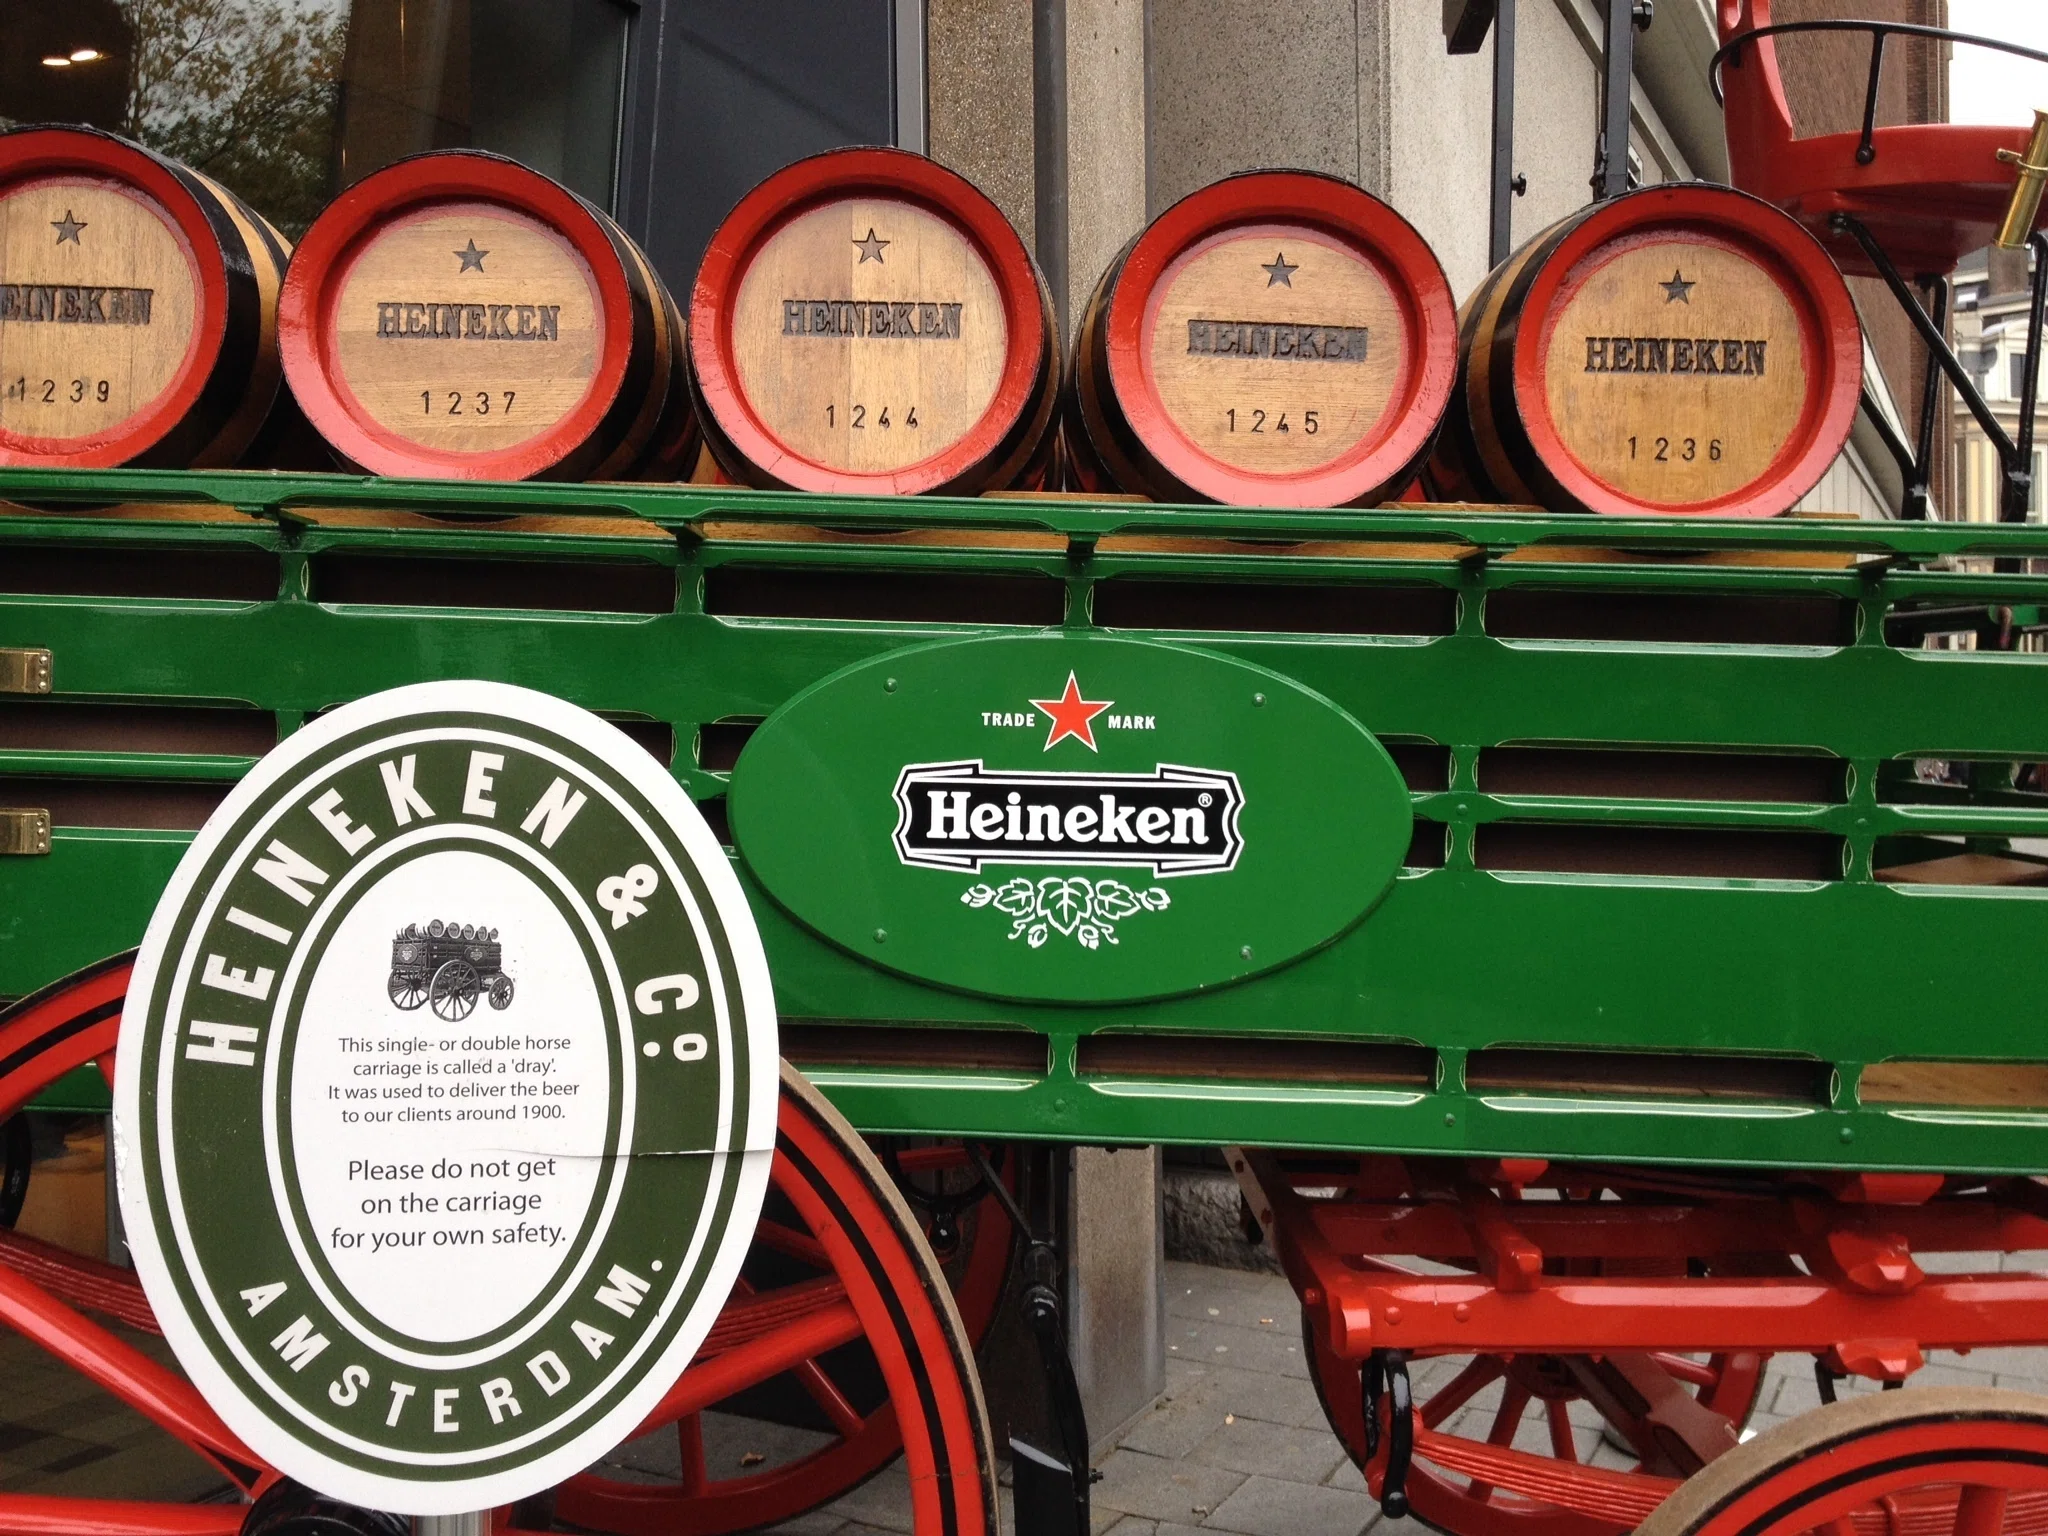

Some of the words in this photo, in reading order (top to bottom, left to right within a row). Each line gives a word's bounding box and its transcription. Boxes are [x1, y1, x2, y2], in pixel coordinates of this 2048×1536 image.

[0, 284, 153, 325] EINEKEN
[376, 302, 561, 342] HEINEKEN
[781, 300, 963, 339] HEINEKEN
[1187, 319, 1369, 362] HEINEKEN
[1584, 336, 1768, 376] HEINEKEN
[16, 376, 110, 403] 1239
[420, 390, 516, 415] 1237
[825, 404, 919, 429] 1244
[1226, 408, 1319, 435] 1245
[1627, 436, 1722, 461] 1236
[981, 712, 1036, 728] TRADE
[1107, 715, 1156, 730] MARK
[186, 750, 588, 1066] HEINEKEN
[597, 864, 658, 930] &
[339, 1037, 372, 1052] This
[378, 1036, 435, 1055] single-
[439, 1040, 457, 1051] or
[461, 1035, 520, 1051] double
[526, 1035, 571, 1050] horse
[353, 1060, 421, 1079] carriage
[426, 1060, 438, 1075] is
[443, 1059, 492, 1074] called
[497, 1063, 506, 1073] a
[328, 1085, 340, 1100] It
[345, 1088, 377, 1099] was
[383, 1083, 422, 1099] used
[427, 1085, 444, 1098] to
[449, 1082, 506, 1098] deliver
[510, 1081, 538, 1097] the
[542, 1080, 580, 1096] beer
[341, 1111, 359, 1123] to
[364, 1111, 393, 1123] our
[397, 1106, 452, 1122] clients
[456, 1104, 516, 1121] around
[522, 1104, 566, 1120] 1900.
[349, 1160, 424, 1181] Please
[431, 1158, 462, 1179] do
[470, 1159, 511, 1178] not
[517, 1158, 557, 1182] get
[361, 1199, 391, 1215] on
[399, 1191, 439, 1213] the
[445, 1190, 542, 1216] carriage
[331, 1227, 365, 1249] for
[371, 1231, 426, 1254] your
[432, 1229, 484, 1246] own
[492, 1221, 567, 1248] safety.
